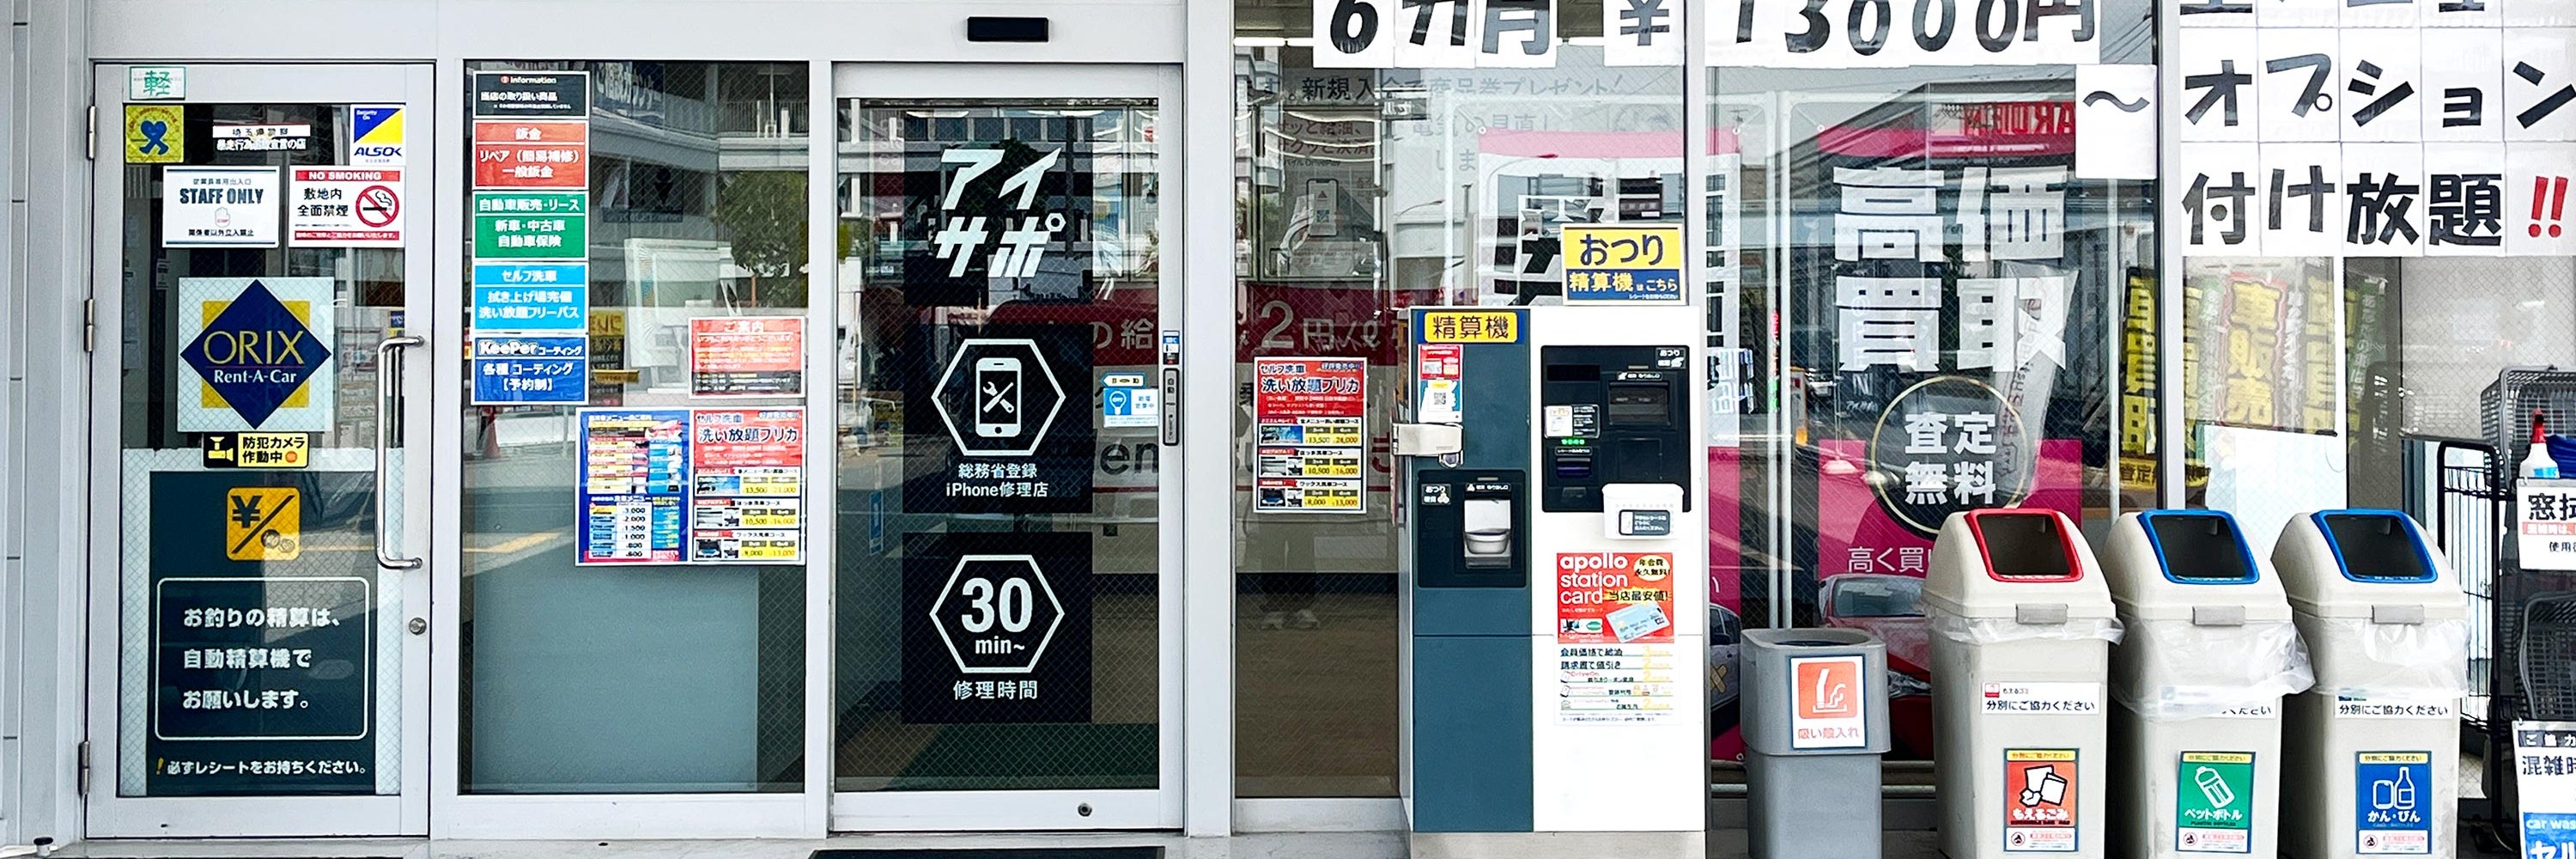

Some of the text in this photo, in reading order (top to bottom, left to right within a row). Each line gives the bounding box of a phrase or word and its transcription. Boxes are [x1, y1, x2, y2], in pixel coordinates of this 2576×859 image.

[143, 70, 173, 96] 軽
[2184, 53, 2576, 130] オプション
[354, 147, 403, 156] ALSOK
[308, 172, 382, 180] NO SMOKING
[941, 147, 1062, 210] アイ
[179, 188, 264, 204] STAFF ONLY
[304, 187, 342, 200] 敷地内
[297, 204, 349, 216] 全面禁煙
[479, 198, 580, 211] 自動車販売・リース
[1833, 166, 2069, 262] 高価
[495, 220, 566, 232] 新車・中古車
[498, 235, 562, 247] 自動車保険
[933, 212, 1066, 277] サポ
[1580, 234, 1663, 265] おつり
[501, 270, 557, 283] セルフ洗車
[479, 306, 580, 319] 洗い放題フリーパス
[1432, 315, 1510, 339] 精算機
[1836, 275, 2066, 373] 買取
[204, 330, 304, 365] ORIX
[214, 369, 297, 383] Rent-A-Car
[1905, 411, 1997, 454] 査定
[242, 436, 305, 450] 防犯カメラ
[242, 451, 283, 464] 作動中
[958, 462, 1038, 478] 総務省登録
[945, 482, 1048, 498] iPhone修理店
[1905, 460, 1997, 505] 無料
[1559, 552, 1629, 573] apollo
[1847, 546, 1932, 574] 高く買
[1560, 571, 1629, 588] station
[1560, 588, 1603, 604] card
[961, 576, 1034, 633] 30
[183, 607, 340, 628] お釣りの精算は、
[183, 649, 313, 669] 自動精算機で
[953, 679, 1038, 700] 修理時間
[183, 690, 309, 710] お願いします。
[1986, 700, 2095, 711] 分別にご協力ください
[2339, 704, 2448, 716] 分別にご協力ください
[1797, 728, 1860, 740] 吸い殻入れ
[2184, 808, 2244, 821] ペットボトル
[2525, 819, 2547, 830] car
